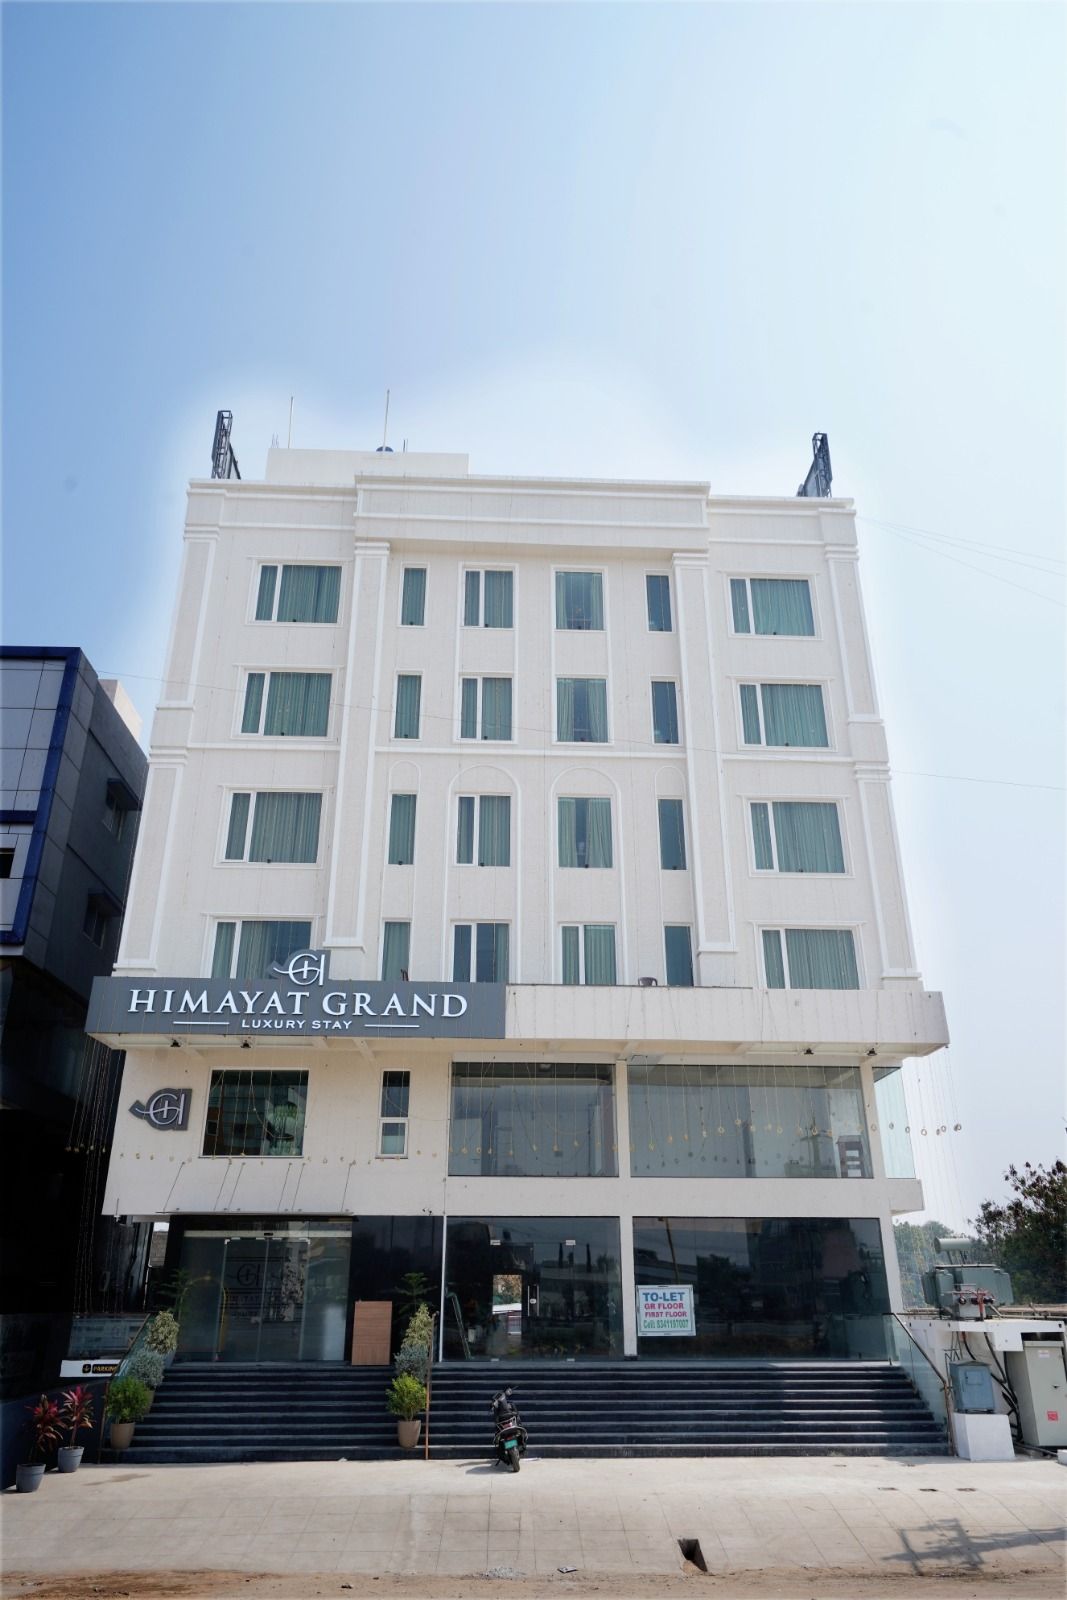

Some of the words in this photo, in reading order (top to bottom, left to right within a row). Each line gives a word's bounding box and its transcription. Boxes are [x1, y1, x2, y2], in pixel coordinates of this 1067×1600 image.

[127, 989, 309, 1015] HIMAYAT
[321, 992, 468, 1018] GRAND
[241, 1019, 306, 1029] LUXURY
[311, 1020, 352, 1030] STAY
[642, 1292, 685, 1301] TO-LET
